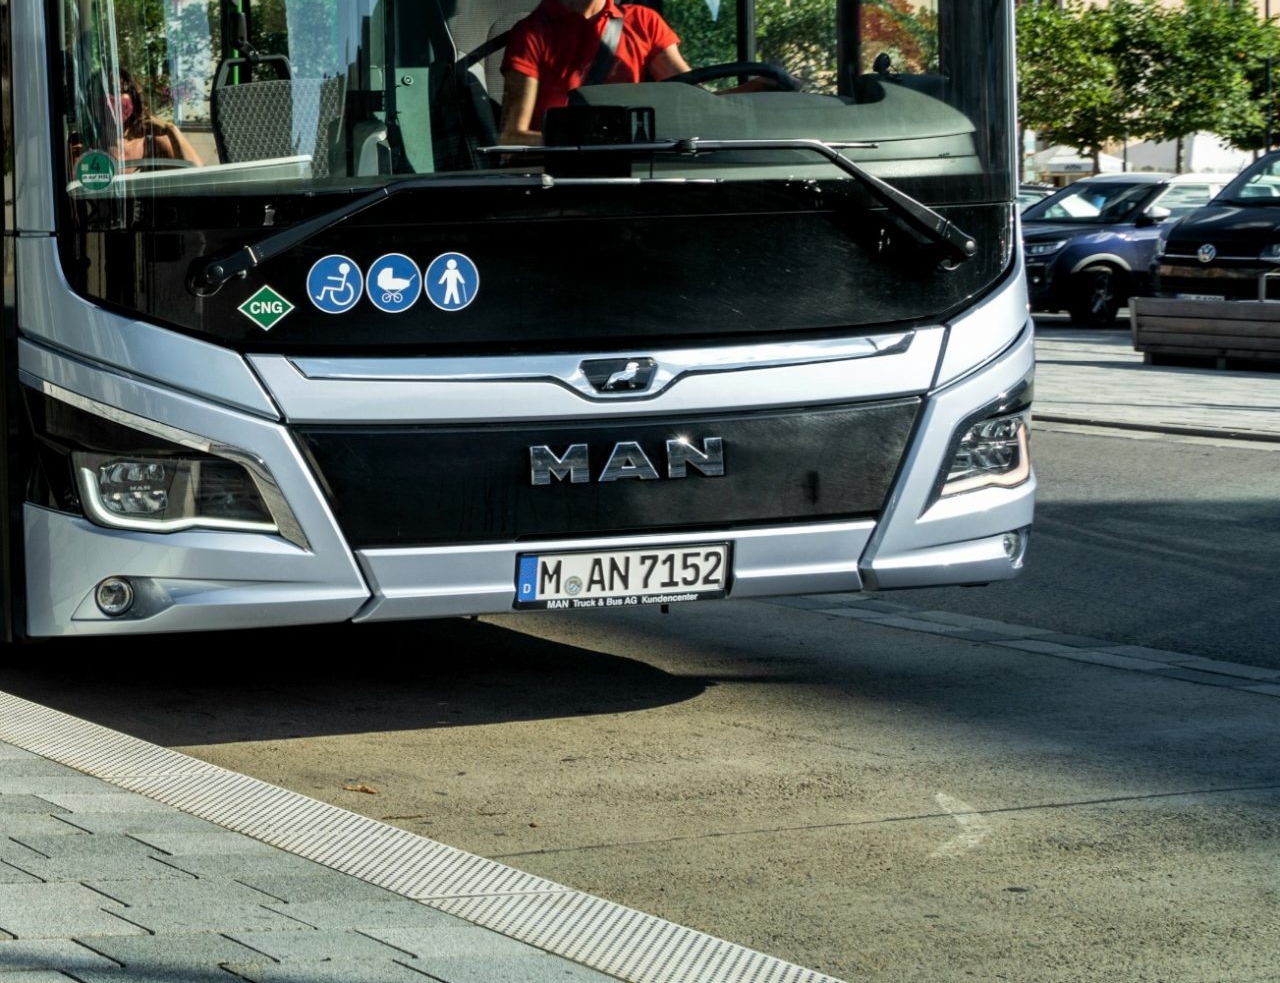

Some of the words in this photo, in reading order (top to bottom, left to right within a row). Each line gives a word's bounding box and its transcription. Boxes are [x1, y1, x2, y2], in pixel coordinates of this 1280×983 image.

[90, 156, 101, 173] 4
[250, 301, 283, 314] CNG
[529, 436, 724, 486] MAN
[539, 559, 562, 595] M
[586, 556, 630, 593] AN
[639, 551, 722, 589] 7152
[522, 583, 531, 594] D
[547, 600, 570, 609] MAN
[573, 599, 596, 608] Truck
[598, 598, 605, 606] &
[606, 597, 623, 606] Bus
[624, 596, 638, 605] AG
[641, 593, 699, 604] Kundencenter
